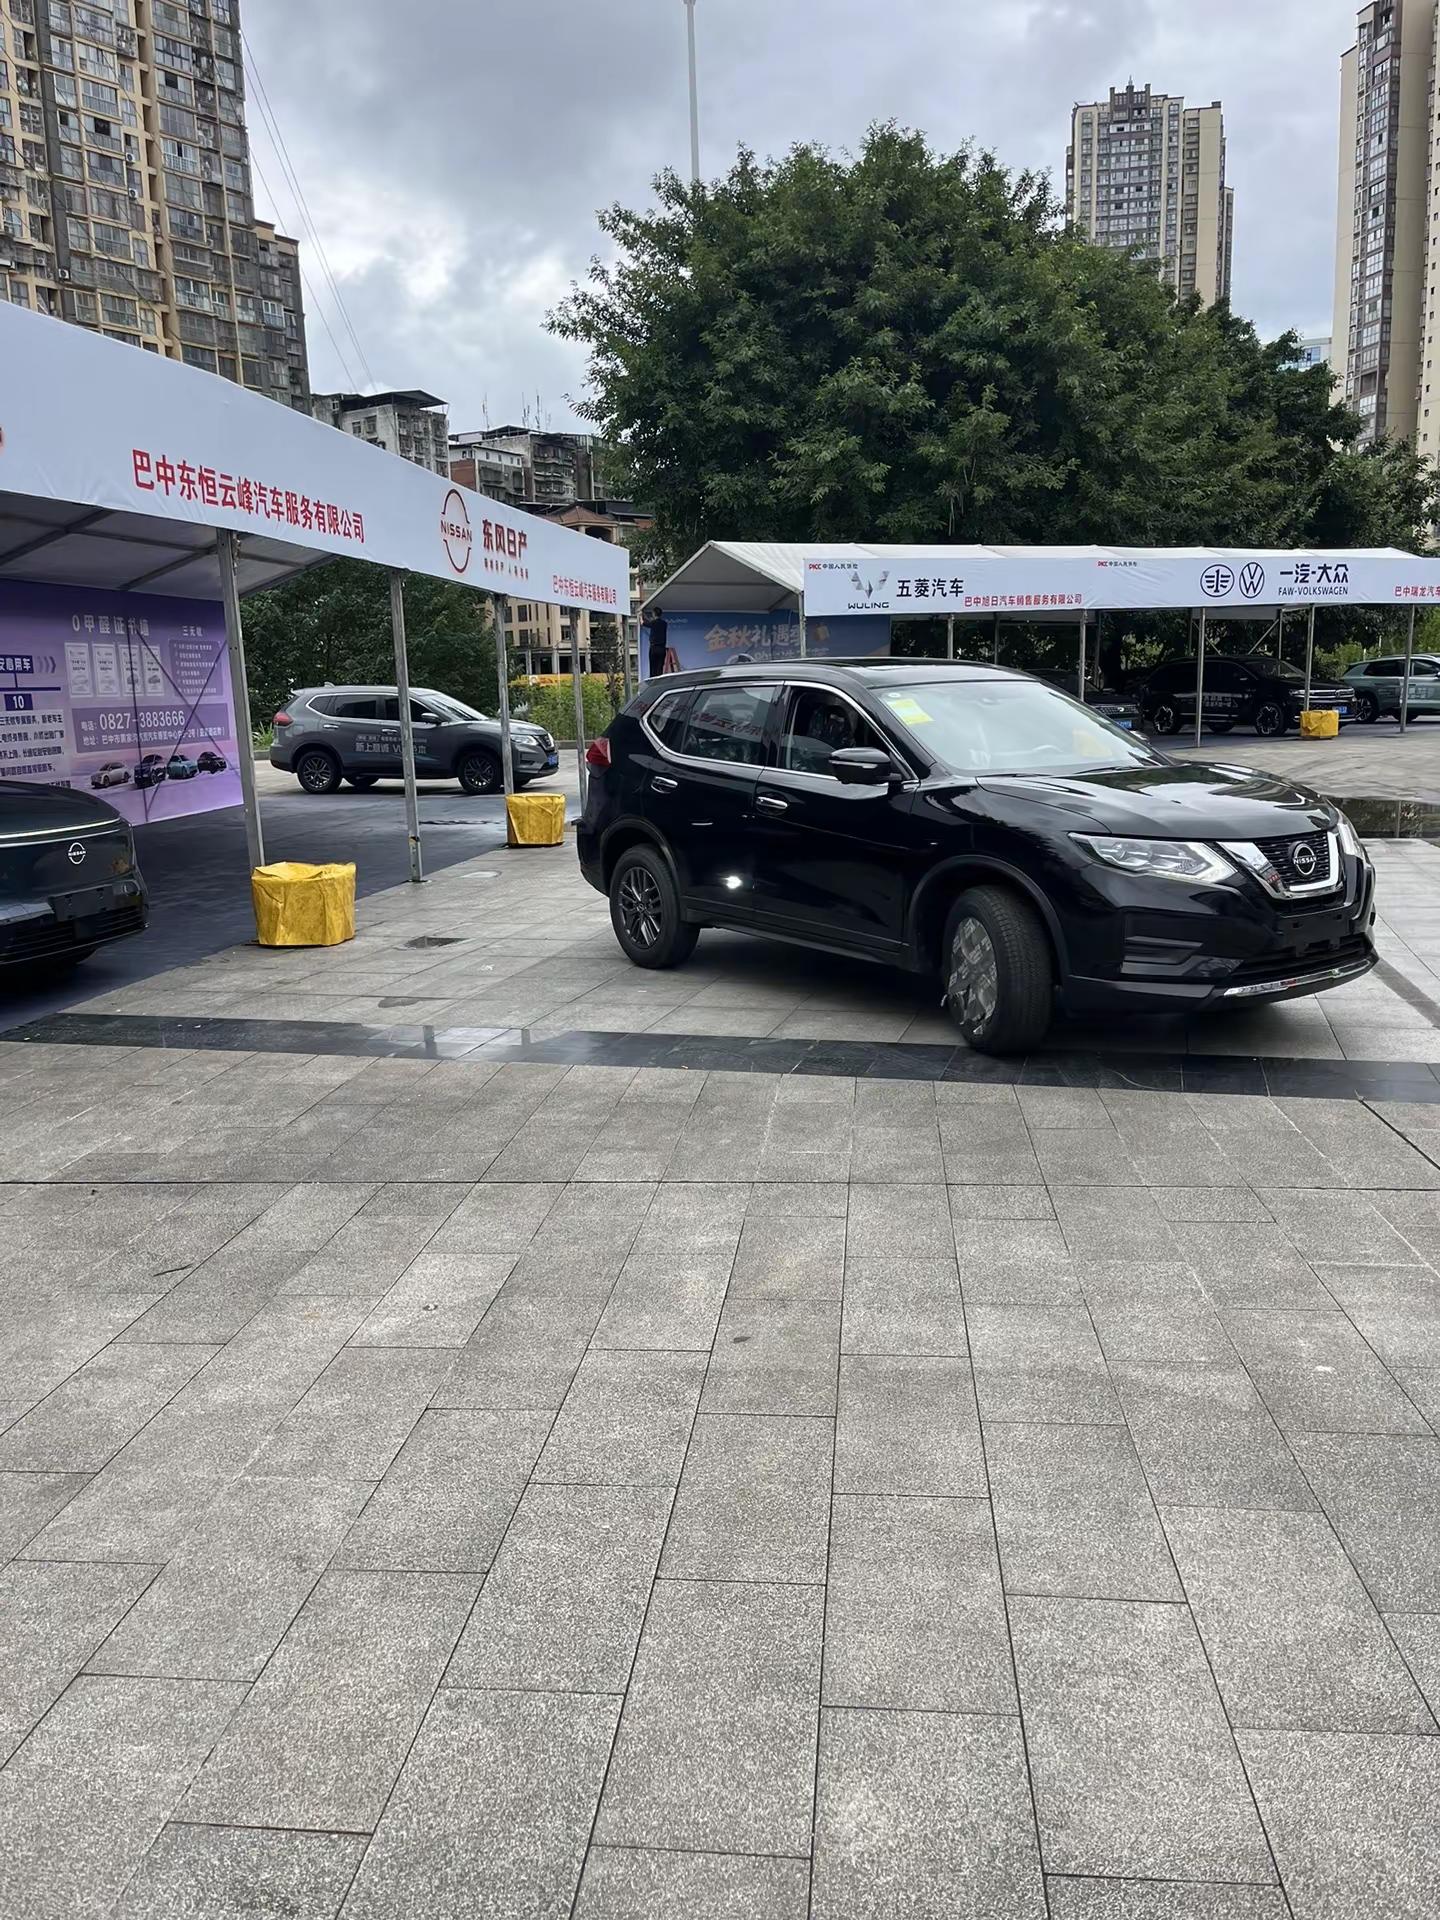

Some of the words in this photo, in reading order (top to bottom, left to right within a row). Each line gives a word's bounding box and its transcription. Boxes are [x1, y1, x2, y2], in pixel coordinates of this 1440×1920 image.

[132, 448, 366, 543] 巴中东恒云峰汽车服务有限公司
[440, 521, 473, 542] NISSAN
[482, 519, 528, 561] 东风日产
[896, 578, 964, 598] 五菱汽车
[1278, 586, 1349, 597] FAW-VOLKSWAGEN
[848, 601, 890, 610] WULING
[964, 594, 1082, 608] 巴中旭日汽车销售服务有限公司
[13, 696, 25, 709] 10
[99, 711, 186, 730] 0827-3883666
[1293, 856, 1317, 865] NISSAN
